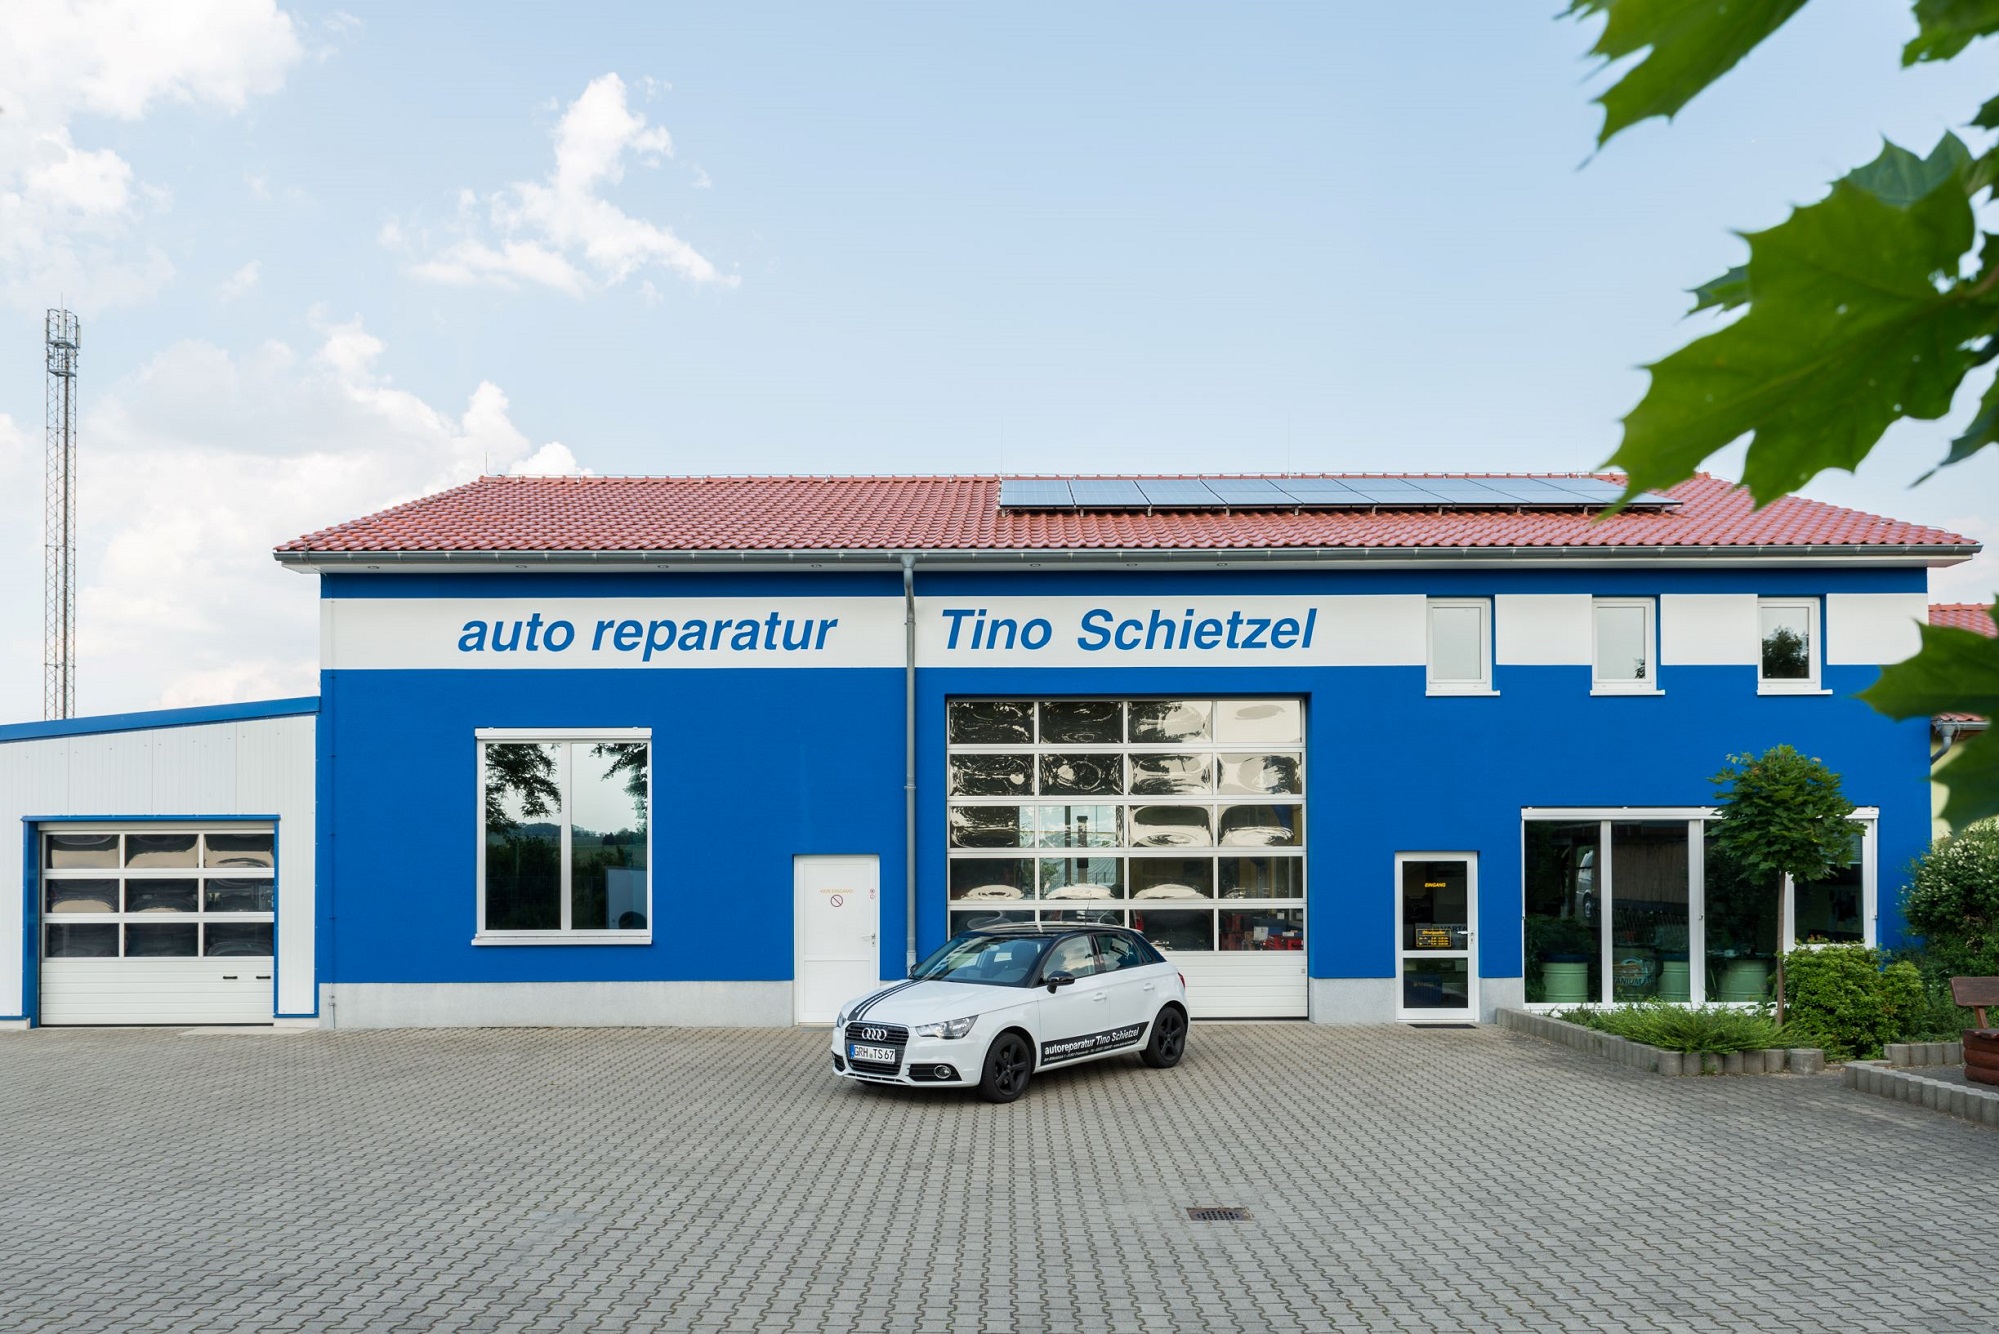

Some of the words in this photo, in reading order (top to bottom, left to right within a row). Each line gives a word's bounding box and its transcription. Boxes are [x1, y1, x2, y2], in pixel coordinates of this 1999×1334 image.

[458, 613, 575, 652] auto
[592, 612, 838, 662] reparatur
[942, 609, 1052, 650] Tino
[1077, 608, 1317, 651] Schietzel
[854, 1046, 868, 1057] GRH
[873, 1048, 883, 1060] TS
[884, 1049, 895, 1061] 67
[1044, 1039, 1095, 1055] autoreparatur
[1095, 1035, 1111, 1046] Tino
[1111, 1026, 1140, 1042] Schietzel
